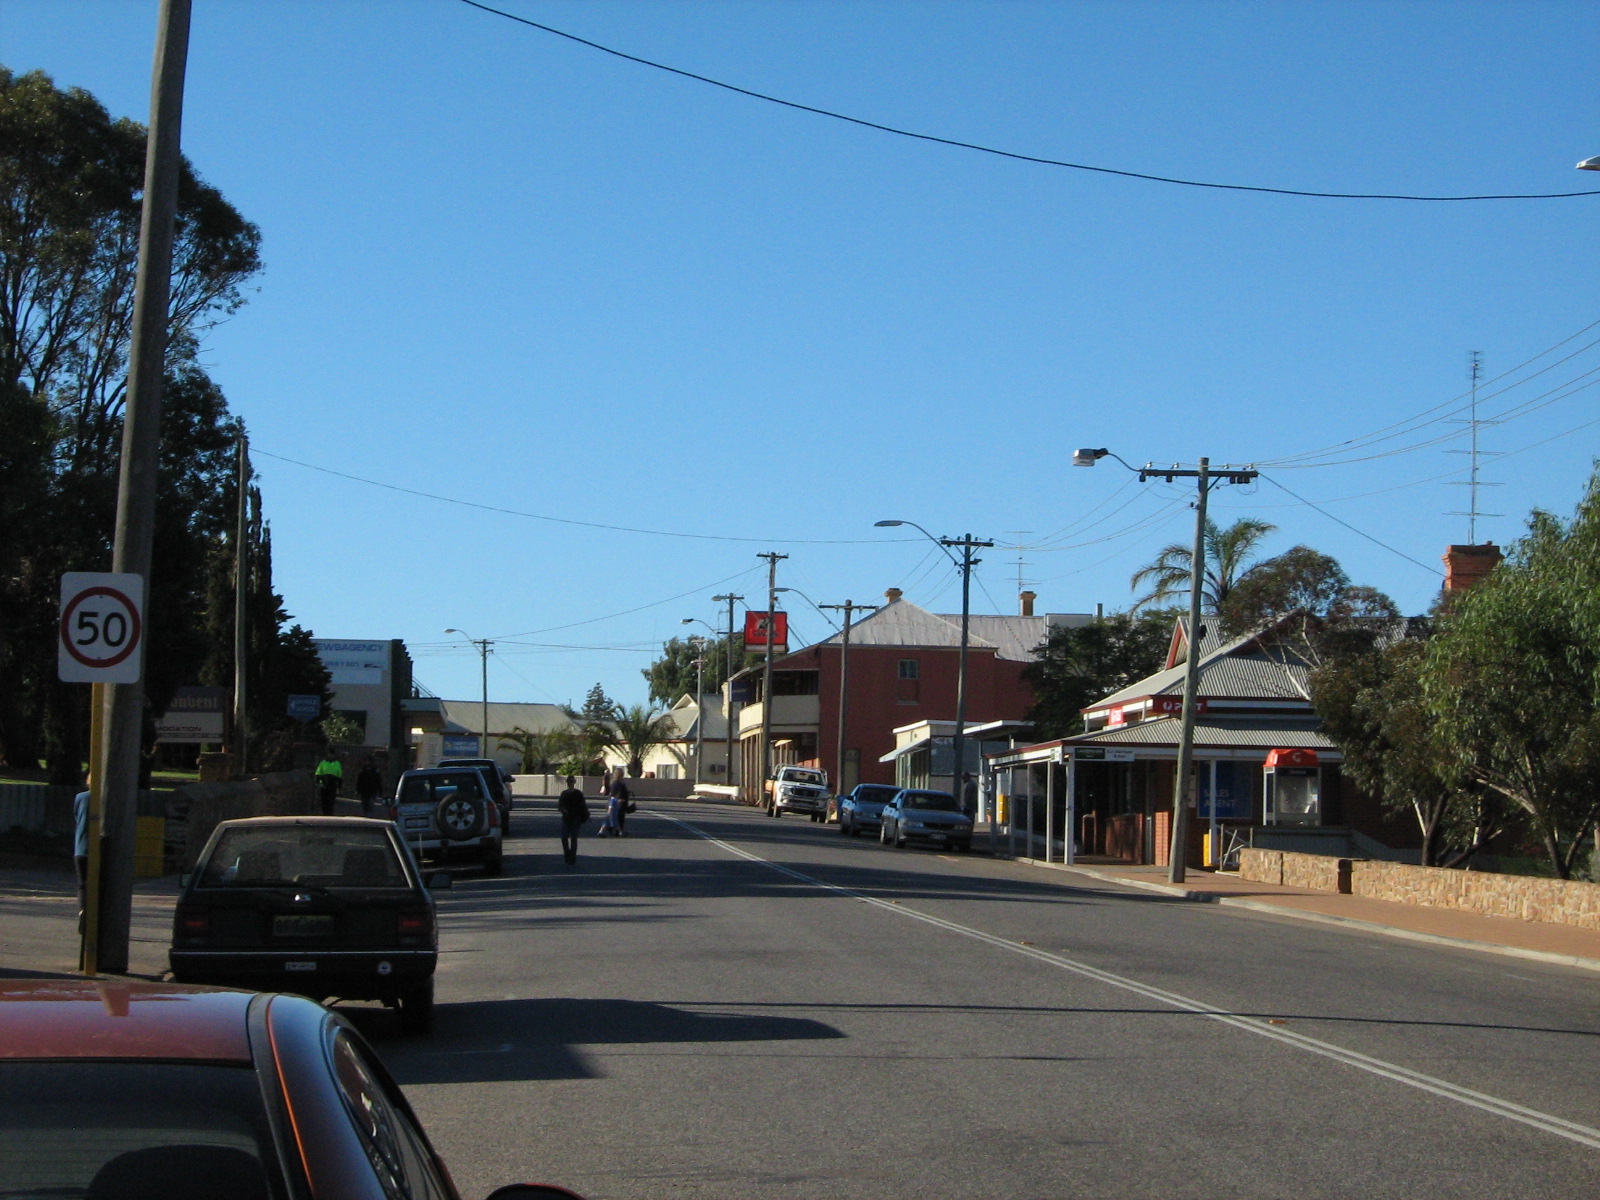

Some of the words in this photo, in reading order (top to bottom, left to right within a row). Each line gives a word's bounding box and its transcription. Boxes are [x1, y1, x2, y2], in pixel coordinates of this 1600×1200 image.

[76, 611, 126, 647] 50
[315, 643, 383, 652] EWSAGENCY
[1174, 702, 1204, 711] PT
[1203, 789, 1230, 798] SLES
[1203, 800, 1235, 808] AENT
